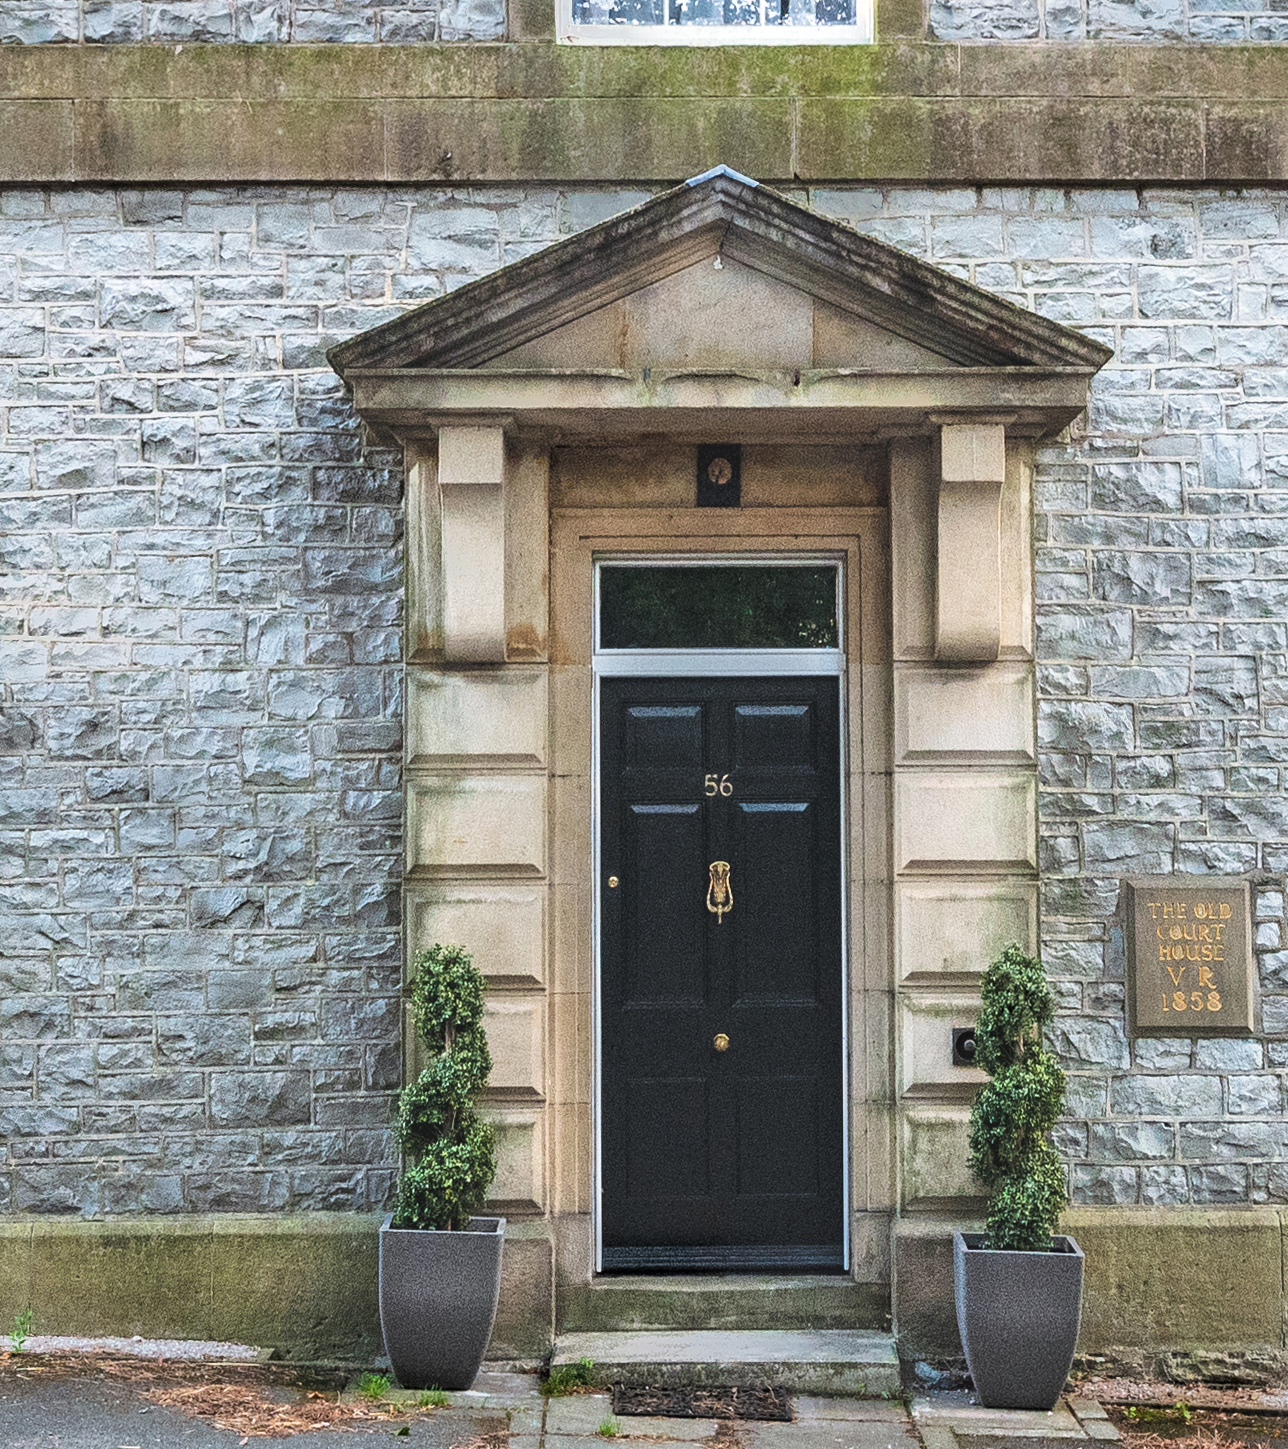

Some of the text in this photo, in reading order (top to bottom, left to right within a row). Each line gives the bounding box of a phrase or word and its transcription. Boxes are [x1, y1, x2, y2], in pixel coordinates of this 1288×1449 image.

[704, 773, 734, 797] 56
[1147, 902, 1233, 919] THE OLD
[1156, 923, 1226, 943] COURT
[1158, 944, 1225, 961] HOUSE
[1166, 966, 1217, 989] V R
[1162, 991, 1222, 1012] 1858
